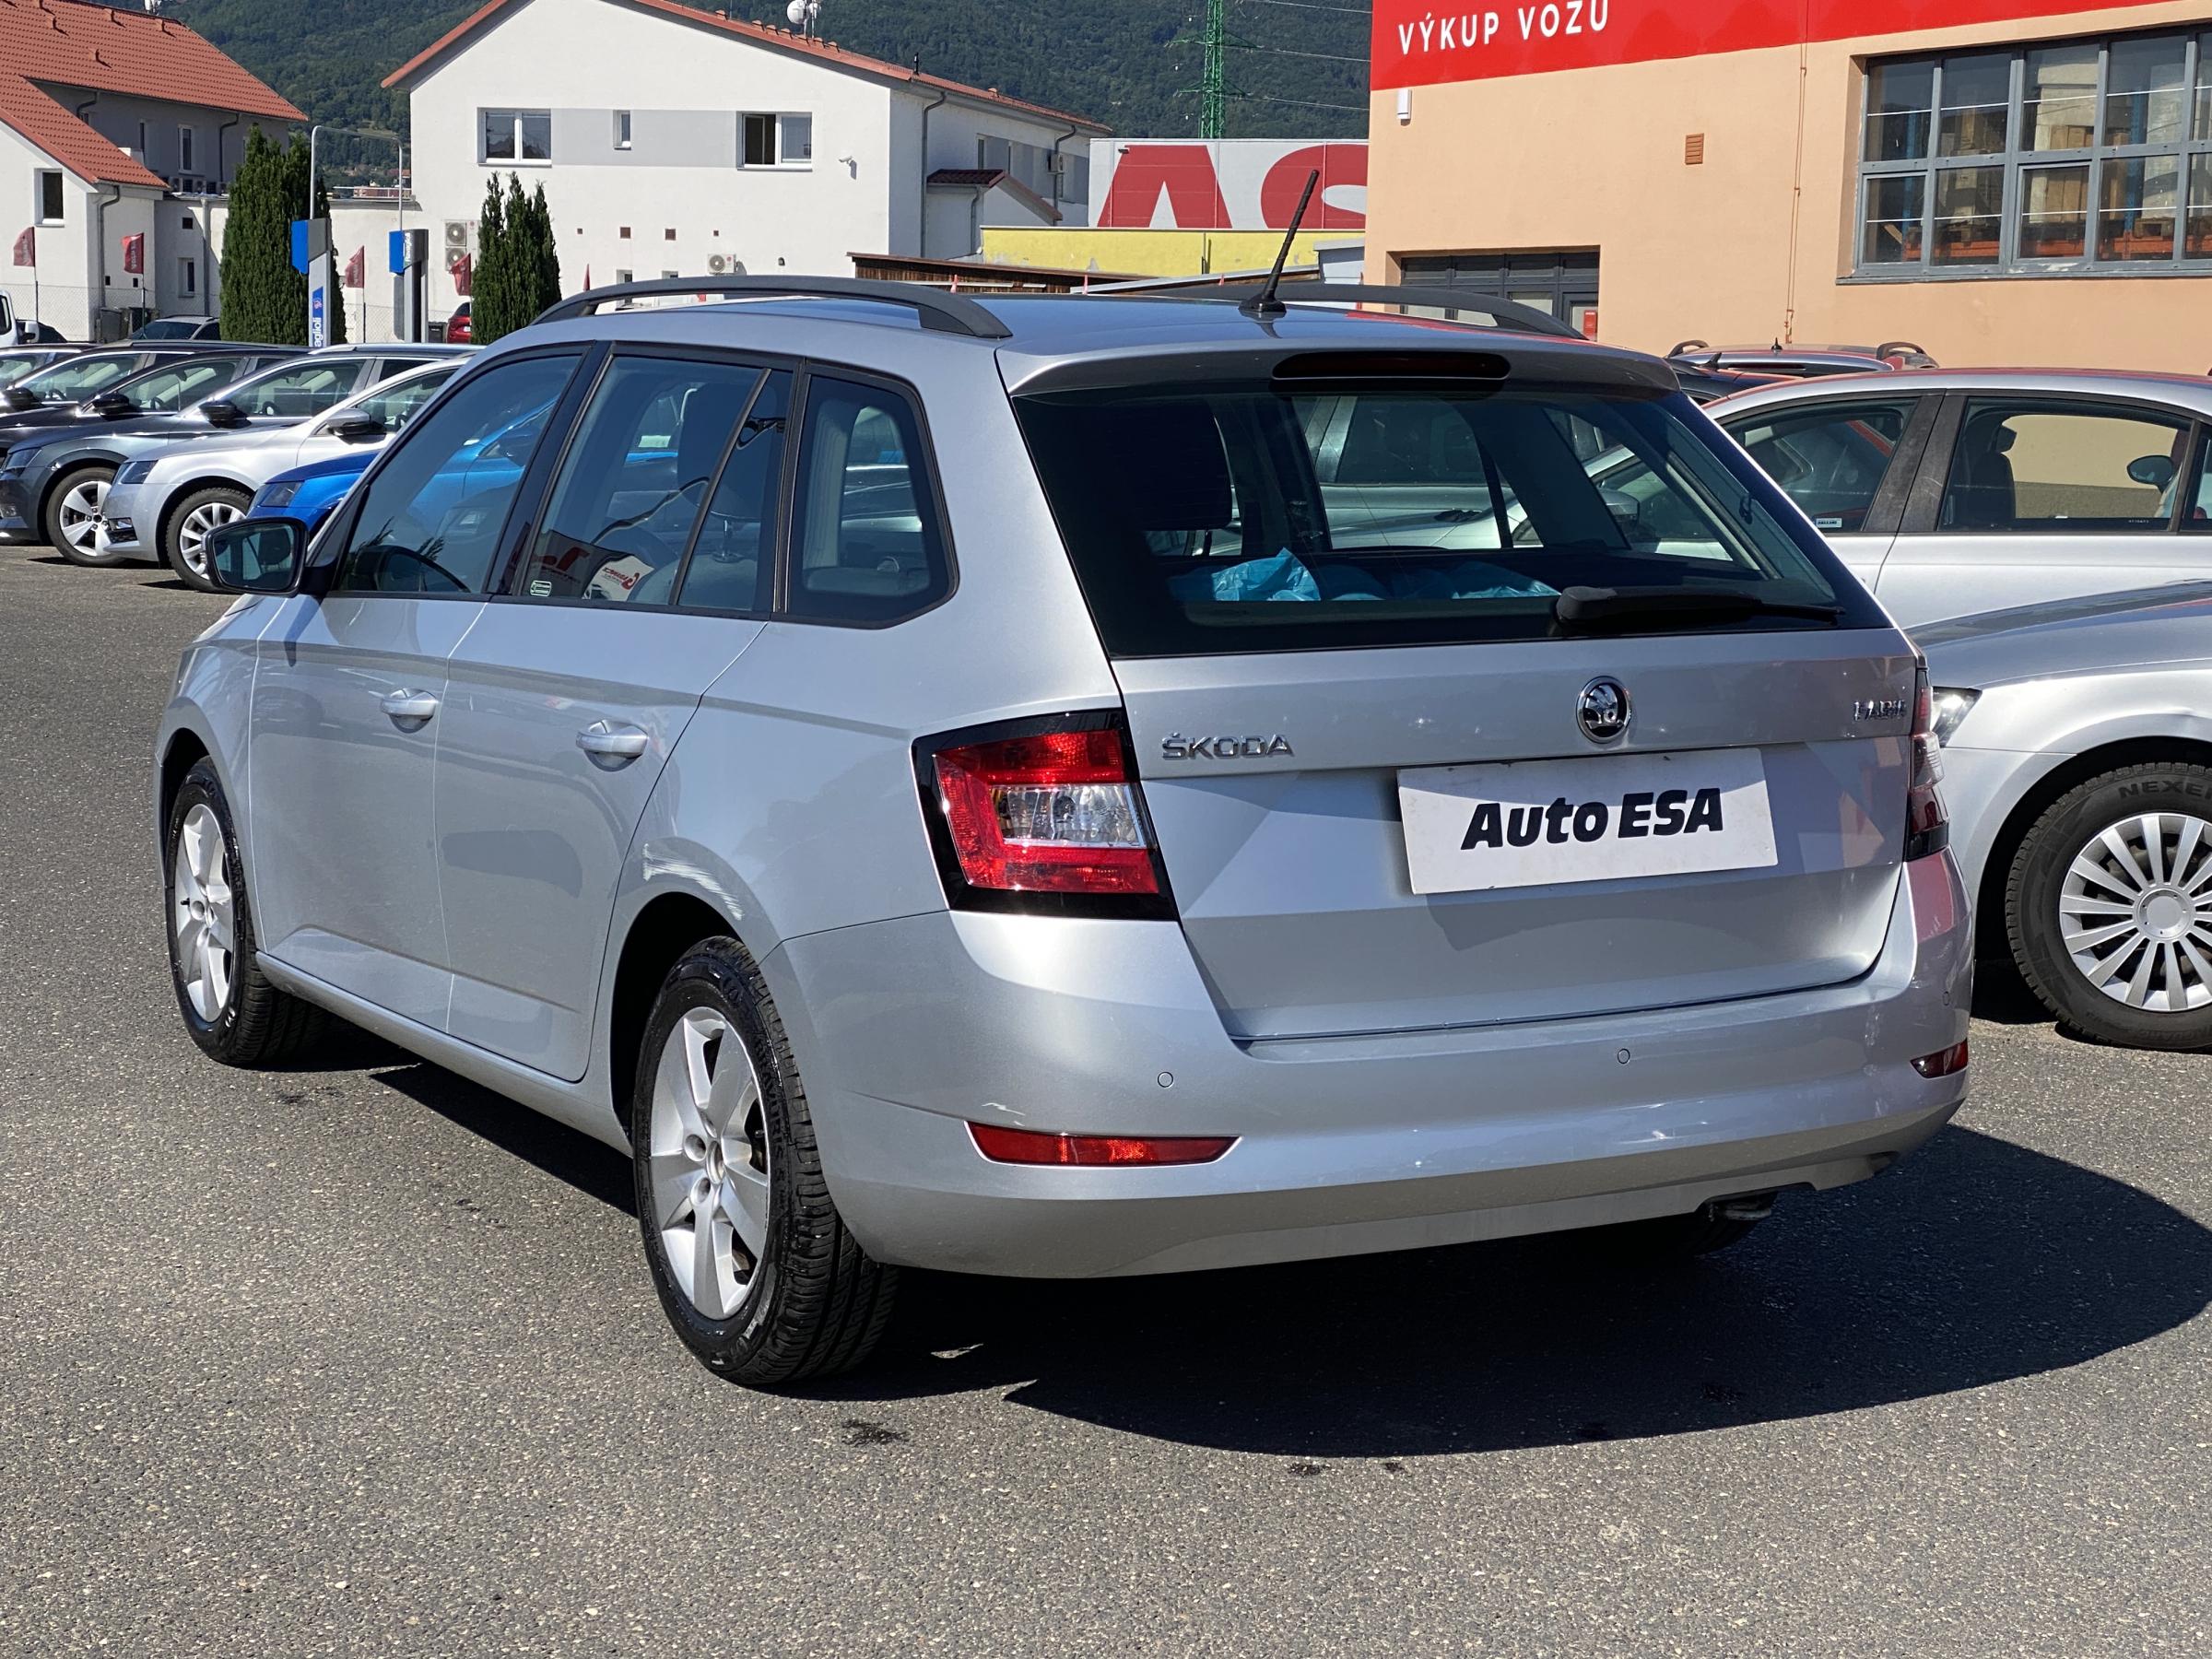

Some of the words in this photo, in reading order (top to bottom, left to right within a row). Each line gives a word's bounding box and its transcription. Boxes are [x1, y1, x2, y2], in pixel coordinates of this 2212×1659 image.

[1398, 12, 1500, 55] VÝKUP
[1161, 732, 1295, 760] ŠKODA
[1460, 797, 1609, 851] Auto
[1618, 787, 1724, 839] ESA
